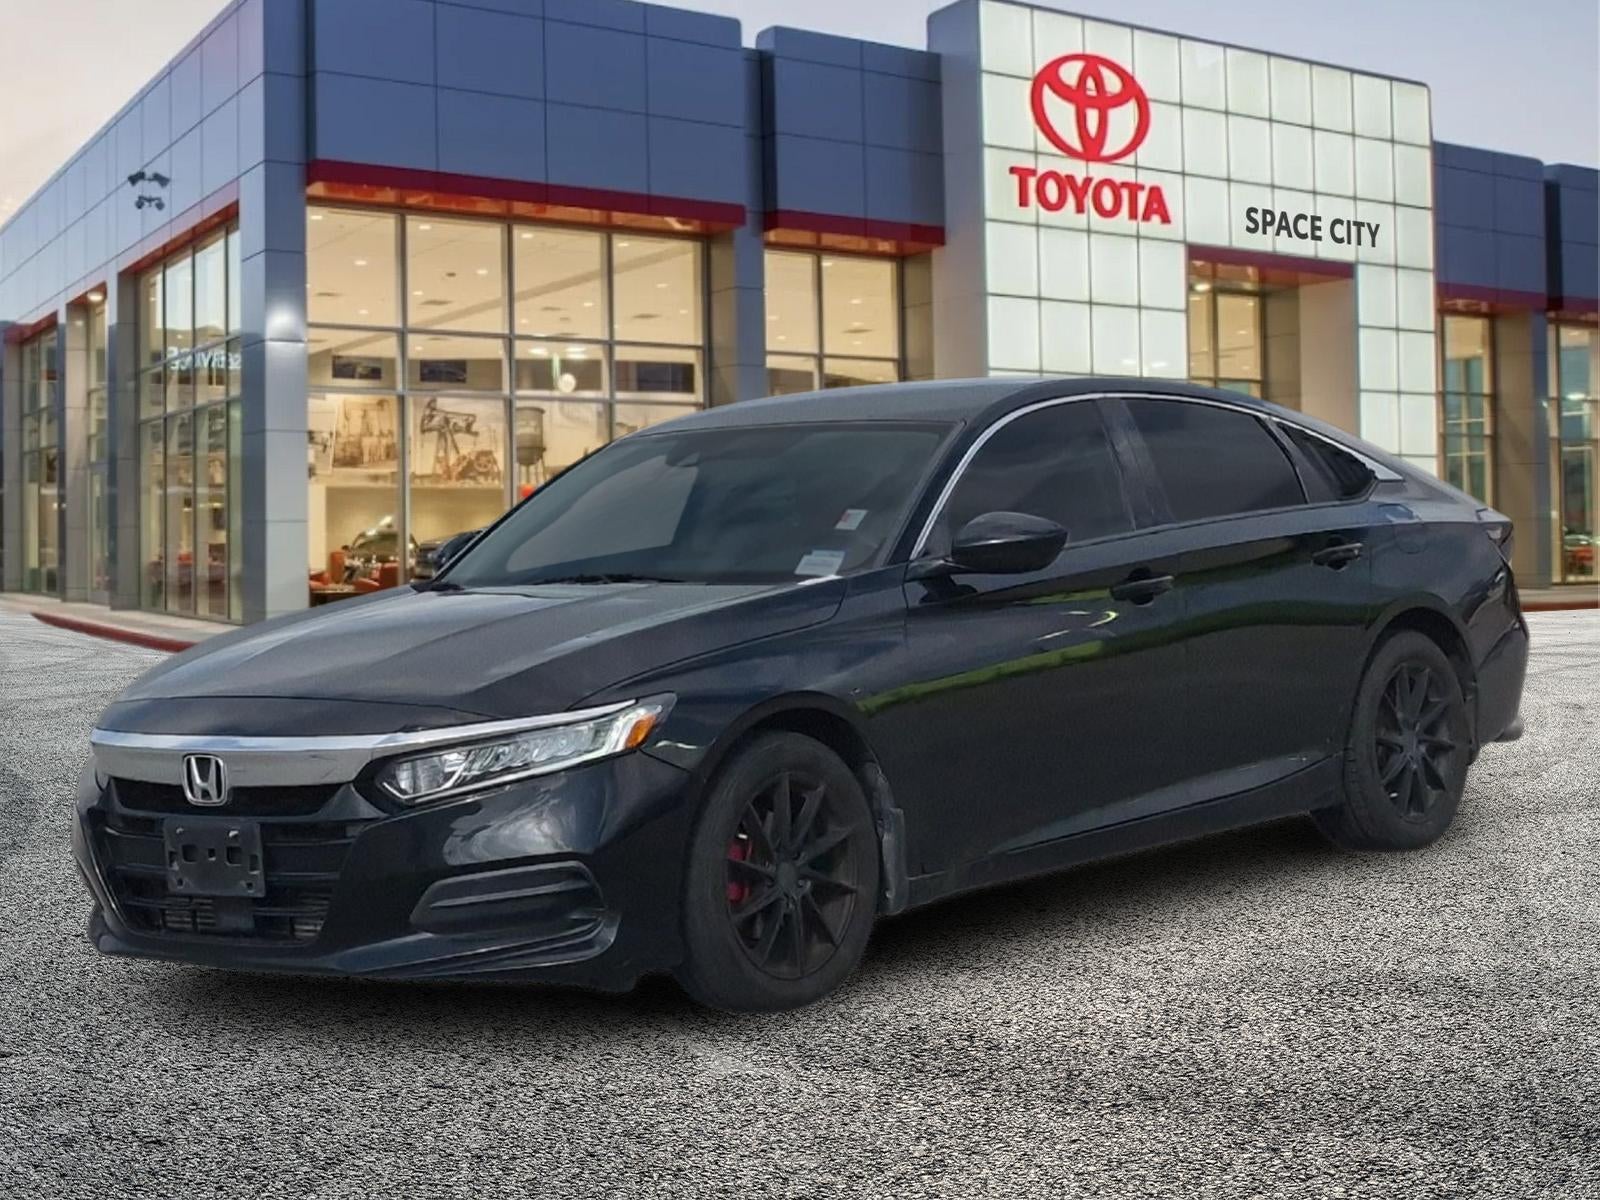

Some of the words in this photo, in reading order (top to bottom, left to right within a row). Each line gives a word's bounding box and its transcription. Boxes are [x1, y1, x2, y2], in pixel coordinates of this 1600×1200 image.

[1009, 166, 1171, 224] TOYOTA
[1245, 206, 1323, 242] SPACE
[1329, 218, 1381, 248] CITY
